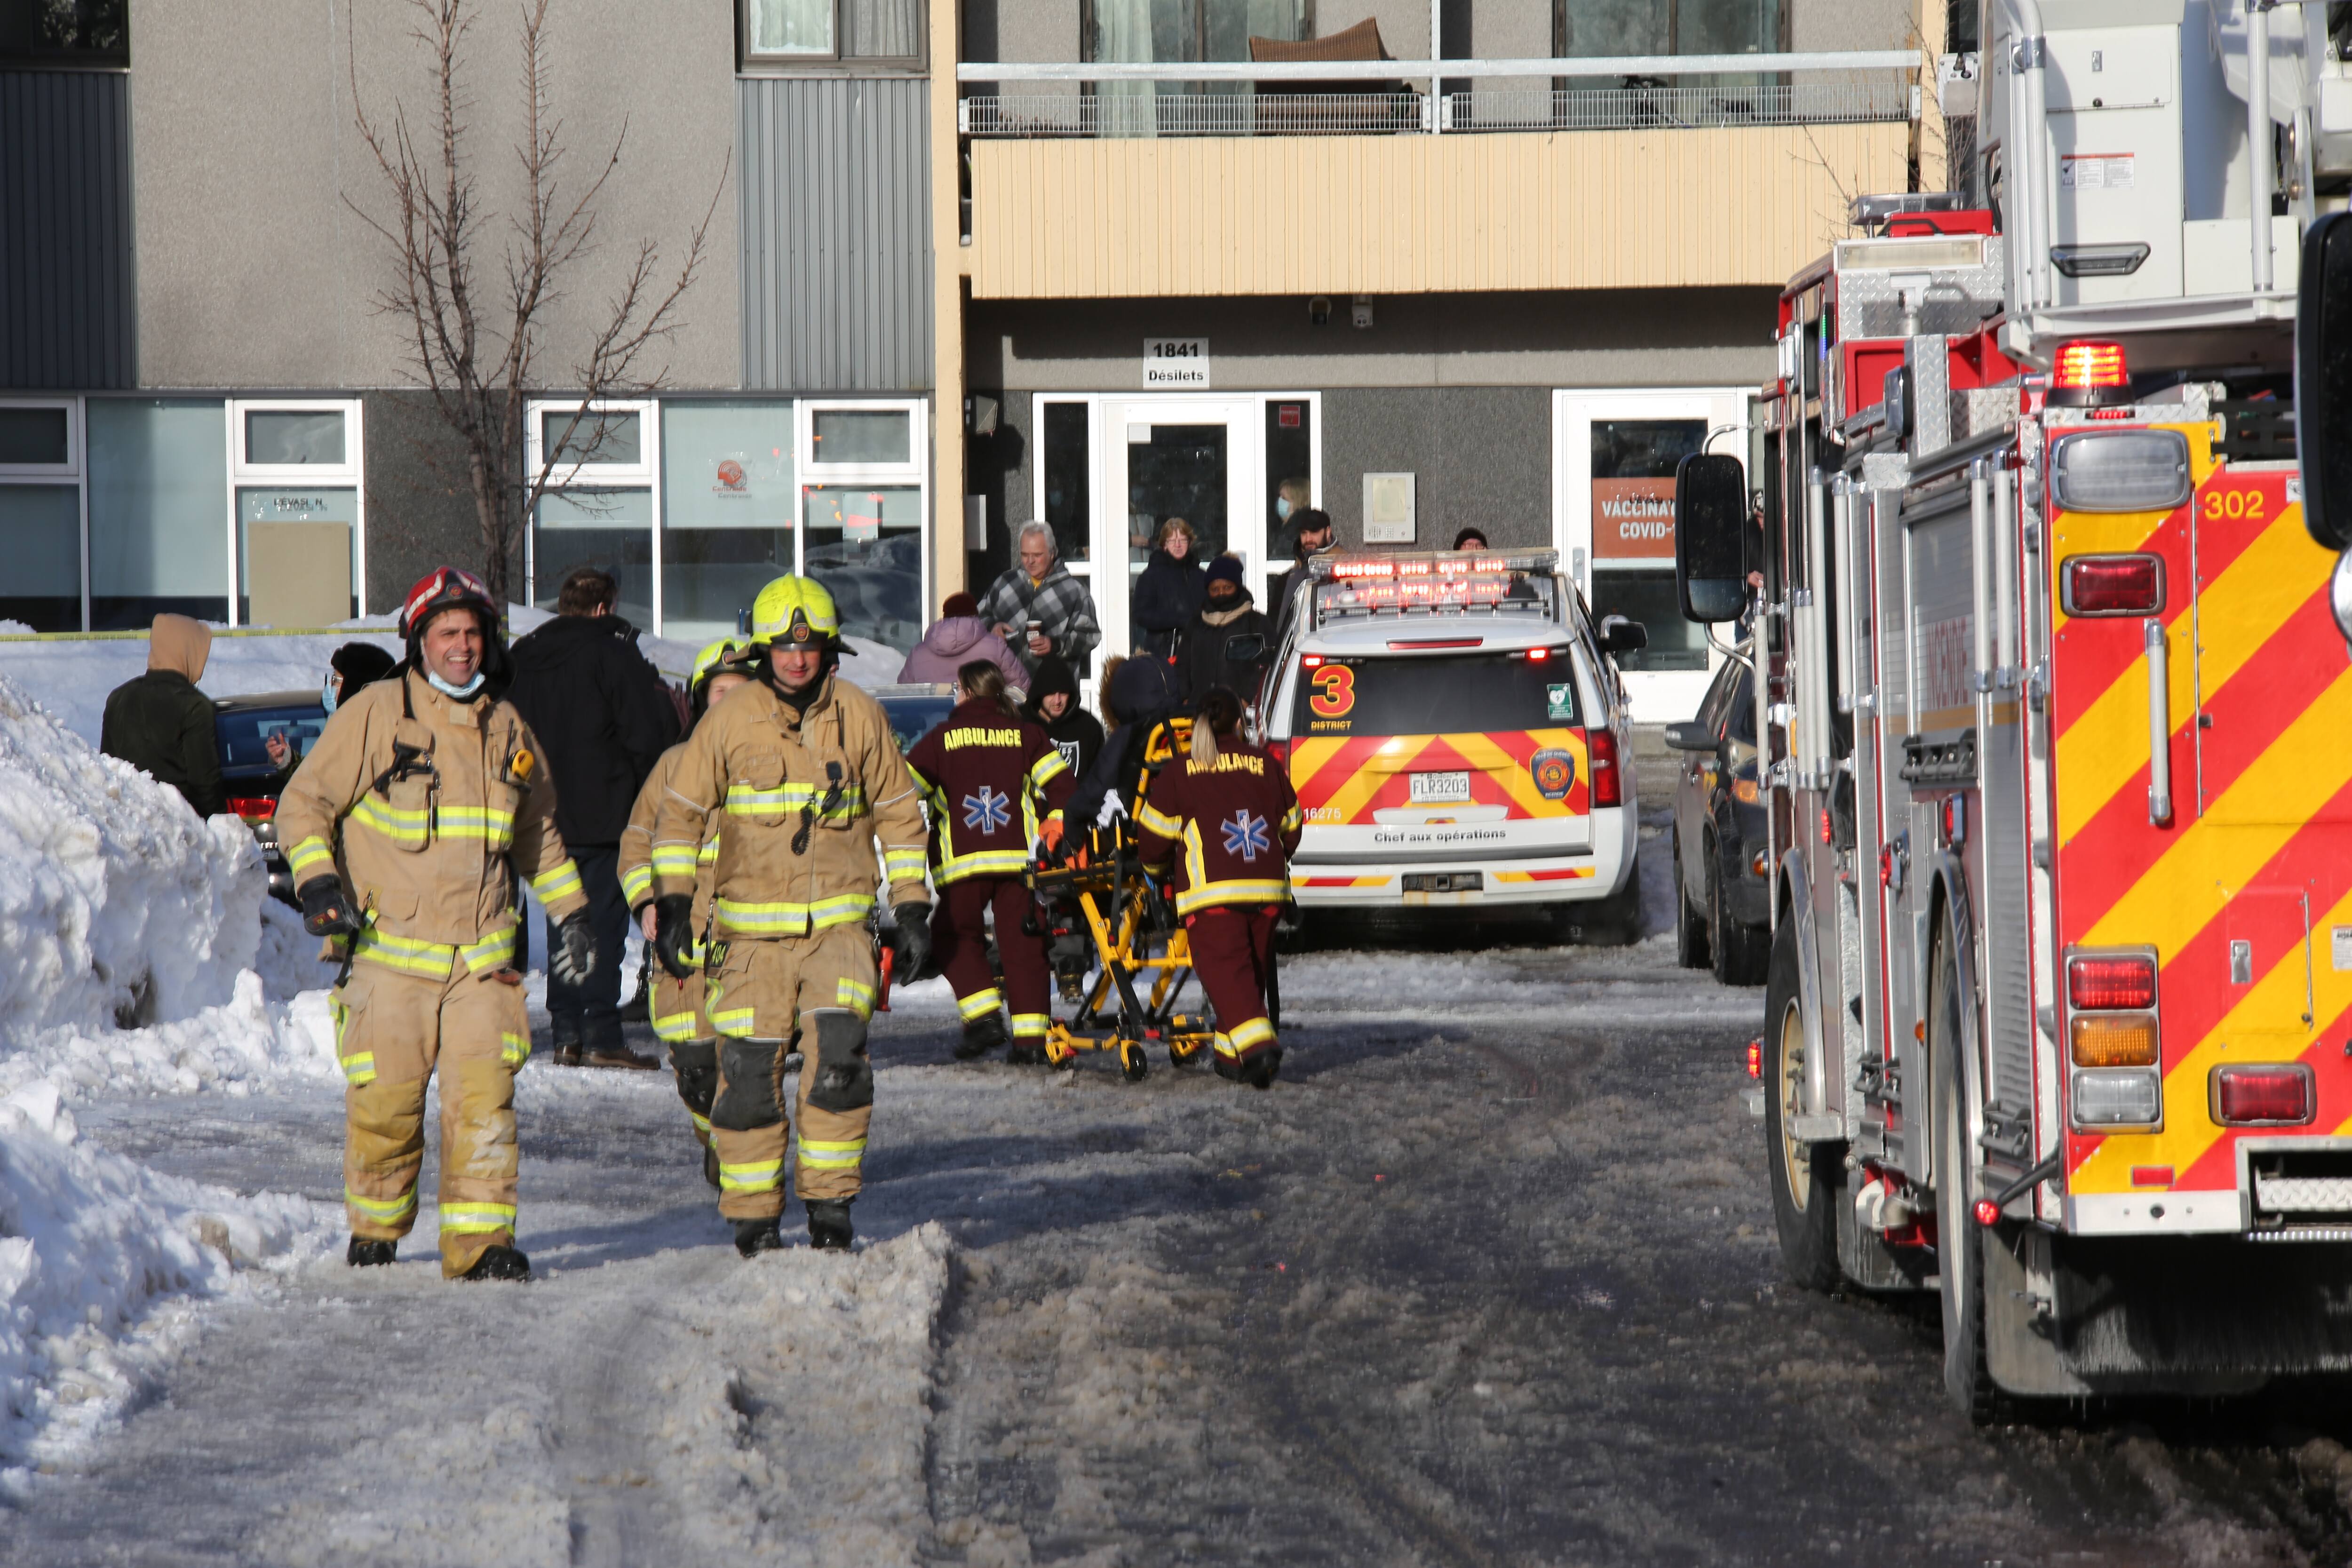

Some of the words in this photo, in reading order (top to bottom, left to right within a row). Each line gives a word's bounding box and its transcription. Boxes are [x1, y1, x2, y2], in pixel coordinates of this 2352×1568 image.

[1153, 342, 1198, 357] 1841
[1149, 369, 1203, 381] Désilets
[2205, 490, 2264, 520] 302
[1310, 664, 1355, 718] 3
[1311, 721, 1352, 731] DISTRICT
[944, 727, 1022, 752] AMBULANCE
[1413, 778, 1467, 794] FLR3203
[1303, 807, 1341, 821] 16275
[1374, 832, 1405, 842] Chef
[1409, 833, 1431, 842] aux
[1437, 829, 1506, 843] opérations
